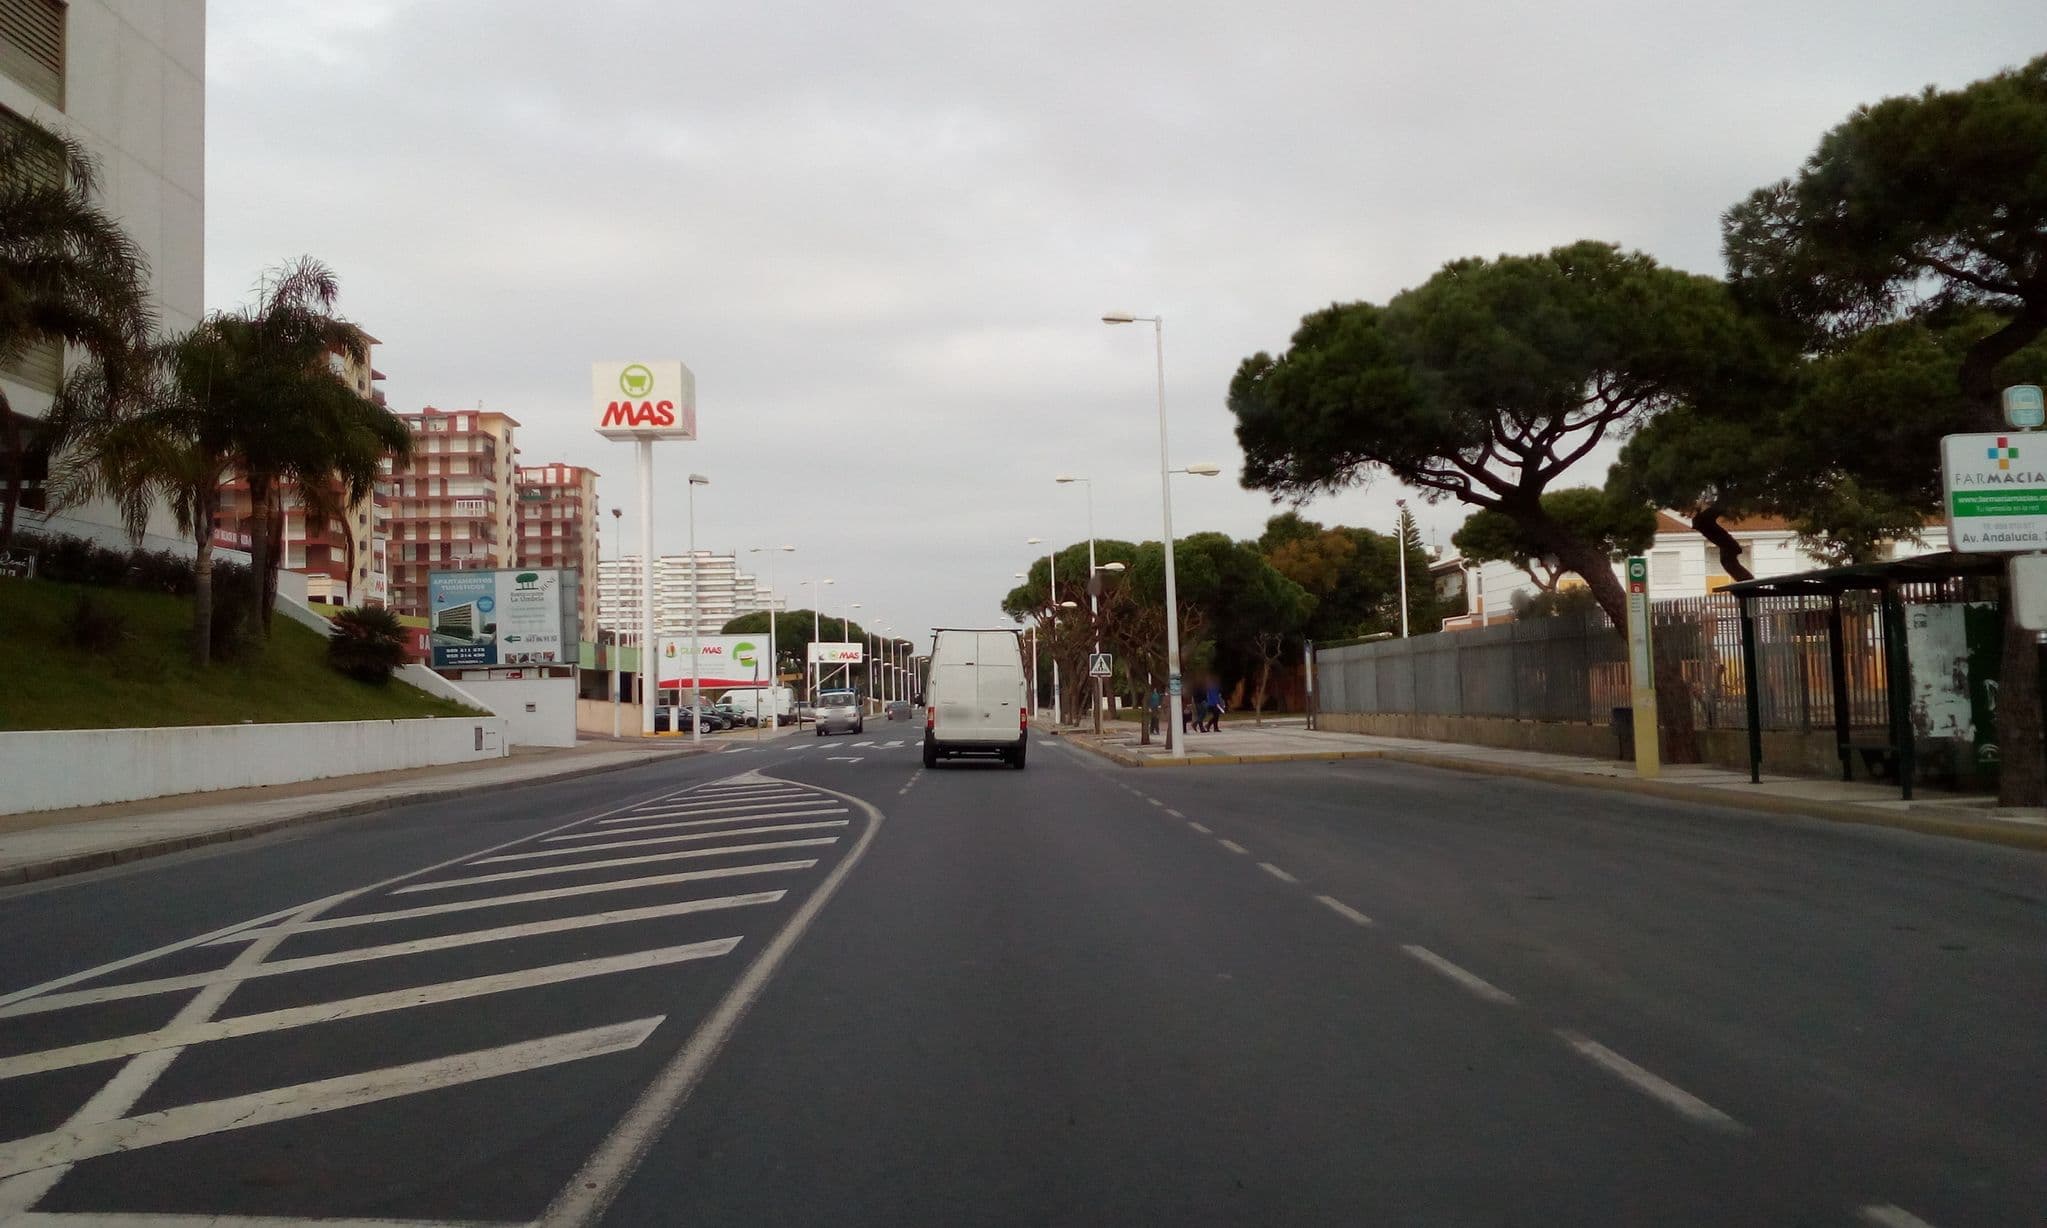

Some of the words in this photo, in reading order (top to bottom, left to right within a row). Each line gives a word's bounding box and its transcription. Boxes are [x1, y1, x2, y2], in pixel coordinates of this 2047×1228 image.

[601, 400, 675, 427] MAS
[1955, 472, 2046, 485] FARMACIA
[1962, 533, 1979, 543] Av.
[702, 646, 722, 655] MAS
[839, 651, 859, 660] MAS
